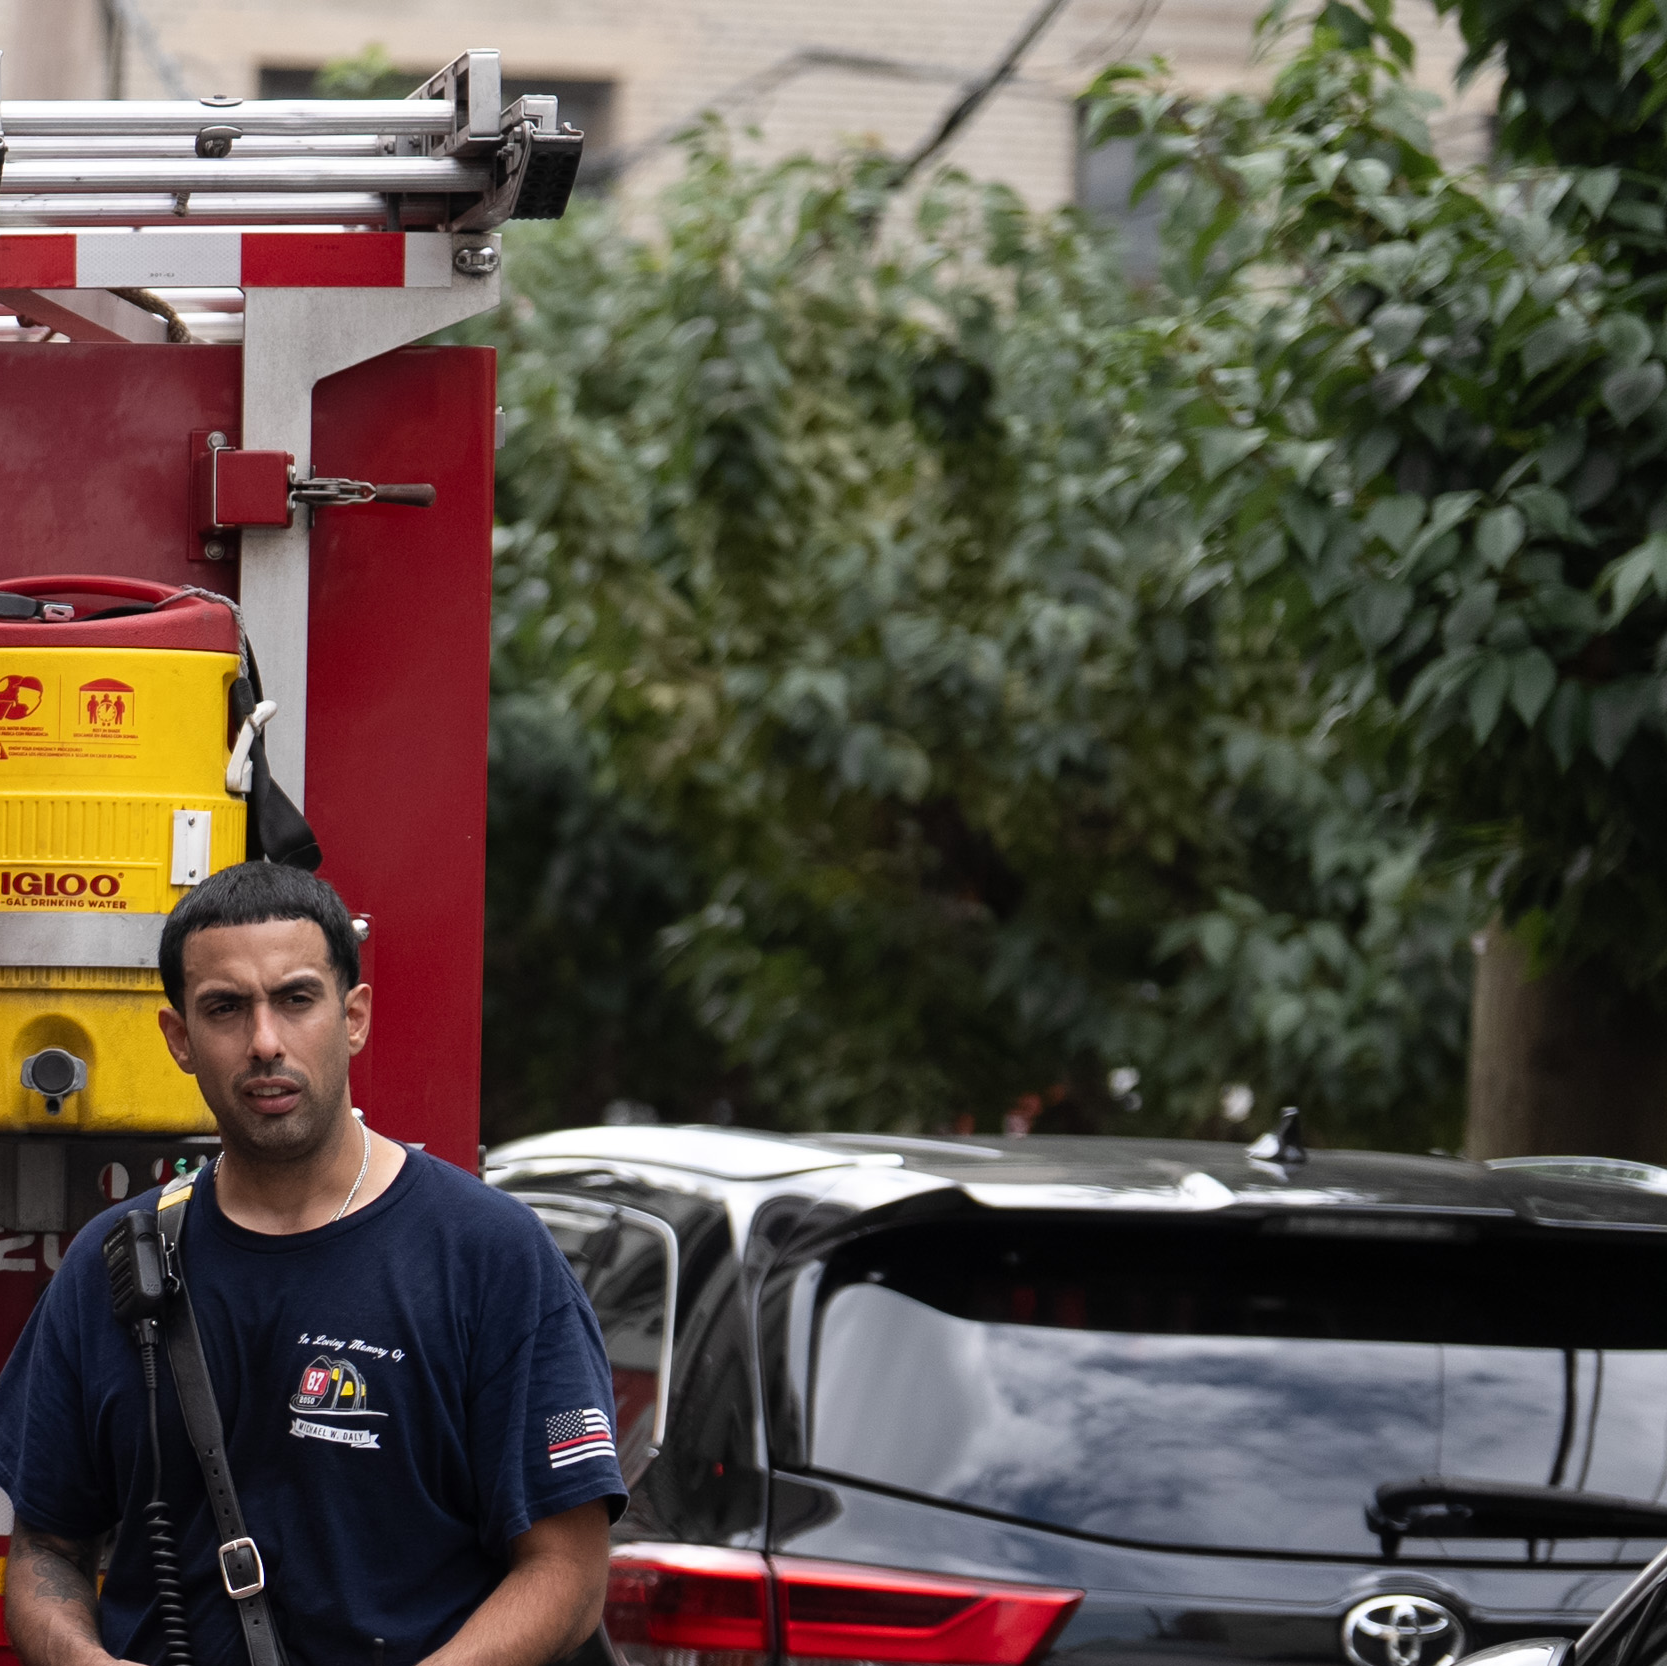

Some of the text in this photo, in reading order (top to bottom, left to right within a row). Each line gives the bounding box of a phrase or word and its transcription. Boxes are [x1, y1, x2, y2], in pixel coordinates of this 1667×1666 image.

[1, 872, 120, 897] IGLOO
[31, 899, 85, 908] DRINKING
[88, 900, 127, 909] WATER
[298, 1333, 310, 1344] In
[312, 1335, 346, 1351] Loving
[348, 1339, 389, 1359] Memory
[307, 1371, 325, 1392] 87
[298, 1422, 364, 1441] MICHAEL W. DALY
